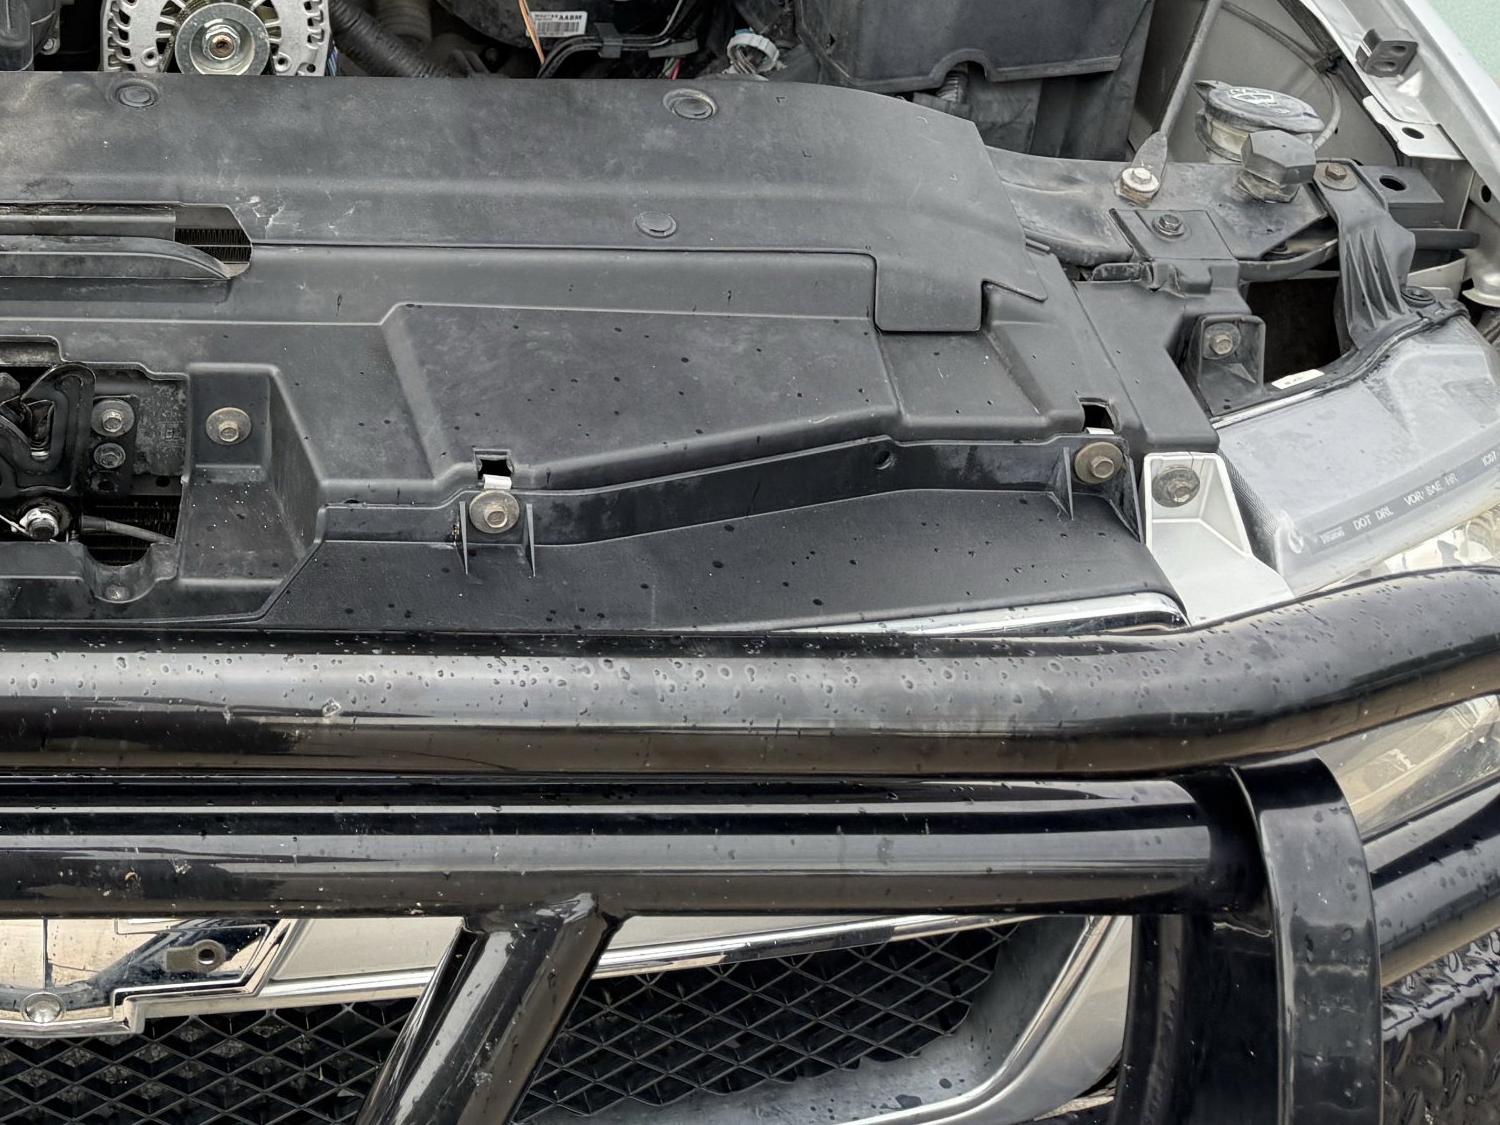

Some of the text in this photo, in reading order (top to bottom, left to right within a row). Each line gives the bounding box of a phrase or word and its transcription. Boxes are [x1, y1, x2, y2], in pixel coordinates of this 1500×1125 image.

[1353, 514, 1373, 531] DOT
[1374, 505, 1395, 522] DRL
[1426, 481, 1444, 497] SAE
[1444, 472, 1461, 488] HR
